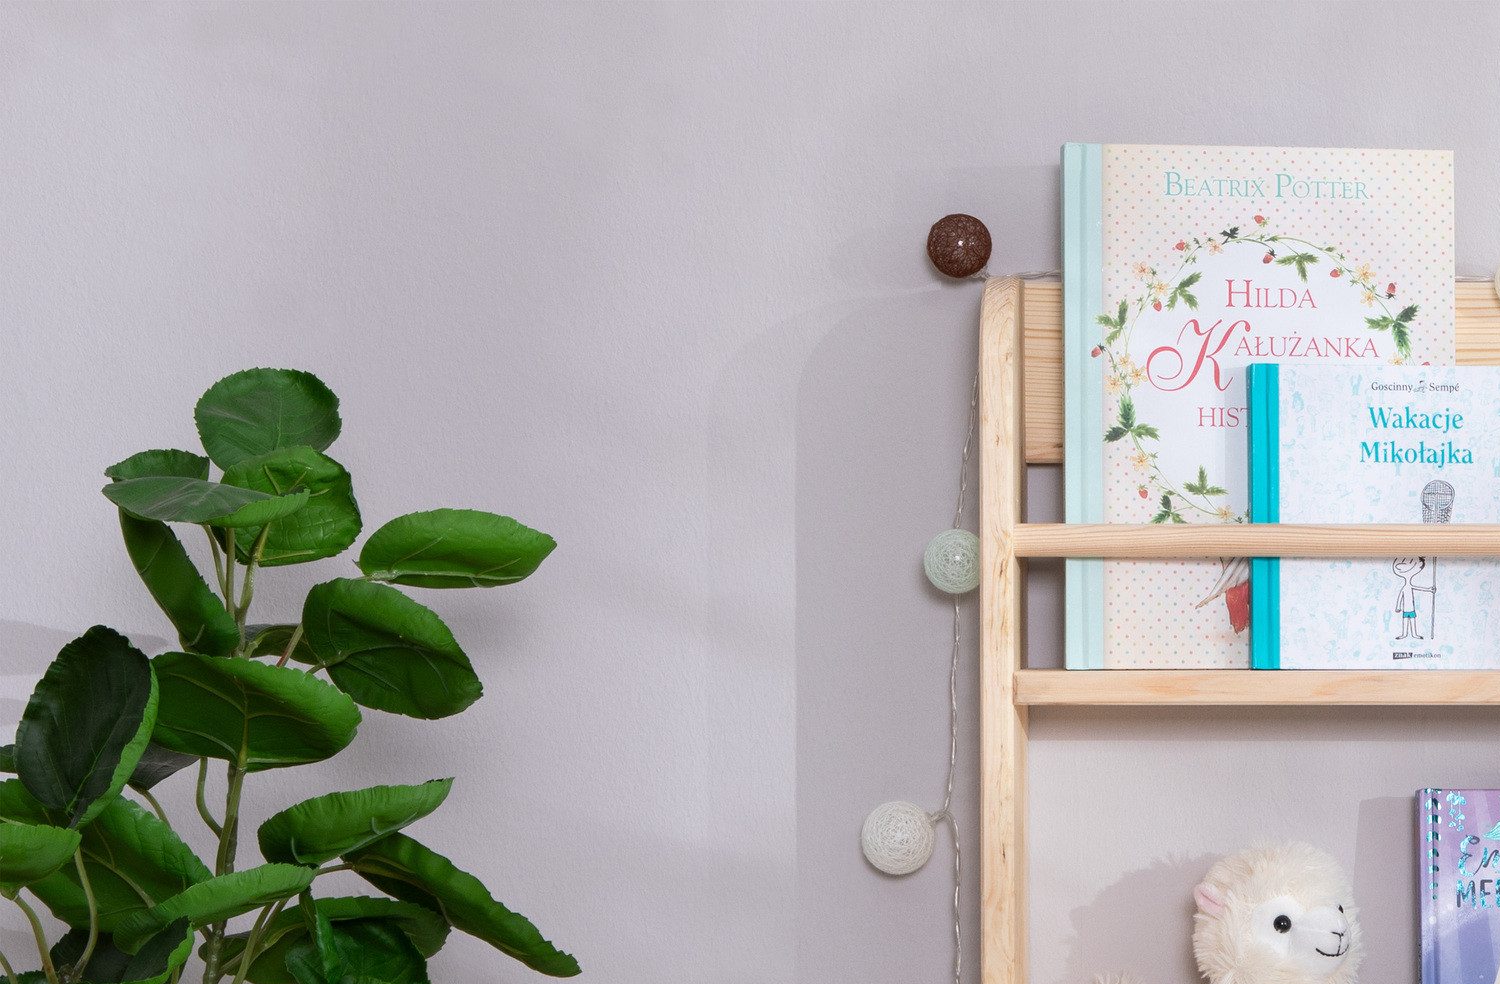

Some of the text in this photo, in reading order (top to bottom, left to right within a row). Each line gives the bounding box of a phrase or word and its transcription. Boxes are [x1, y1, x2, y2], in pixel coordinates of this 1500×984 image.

[1163, 171, 1370, 200] BEATRIX POTTER
[1224, 278, 1317, 309] HILDA
[1146, 318, 1380, 392] KAŁUŻANKA
[1371, 381, 1460, 393] Goscinny Sempé
[1368, 406, 1464, 434] Wakacje
[1360, 440, 1474, 469] Mikołajka
